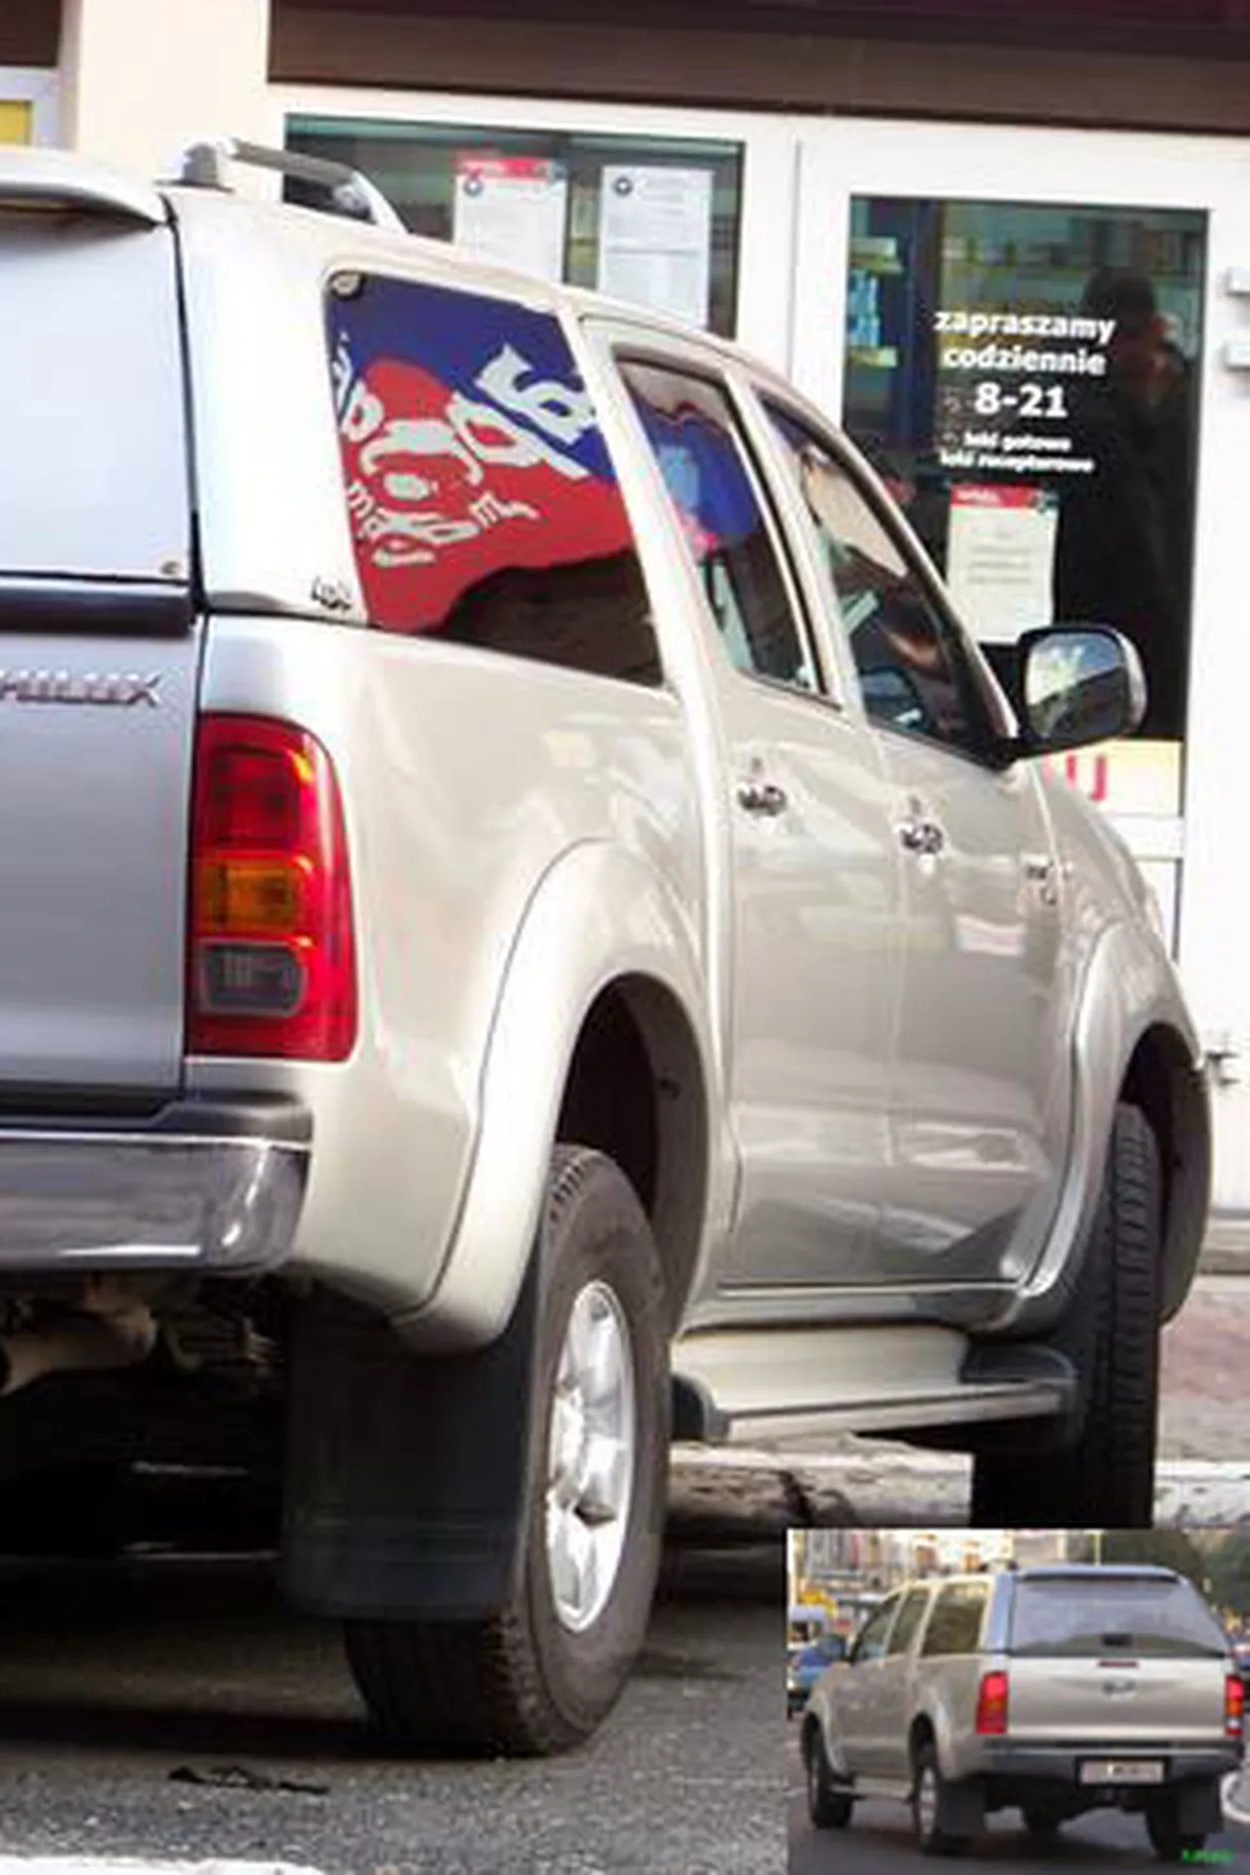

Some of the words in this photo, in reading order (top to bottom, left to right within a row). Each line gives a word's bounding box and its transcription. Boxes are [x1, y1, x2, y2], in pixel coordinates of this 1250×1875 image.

[933, 311, 1117, 345] zapraszamy
[942, 344, 1107, 376] codziennie
[975, 381, 1068, 418] 8-21
